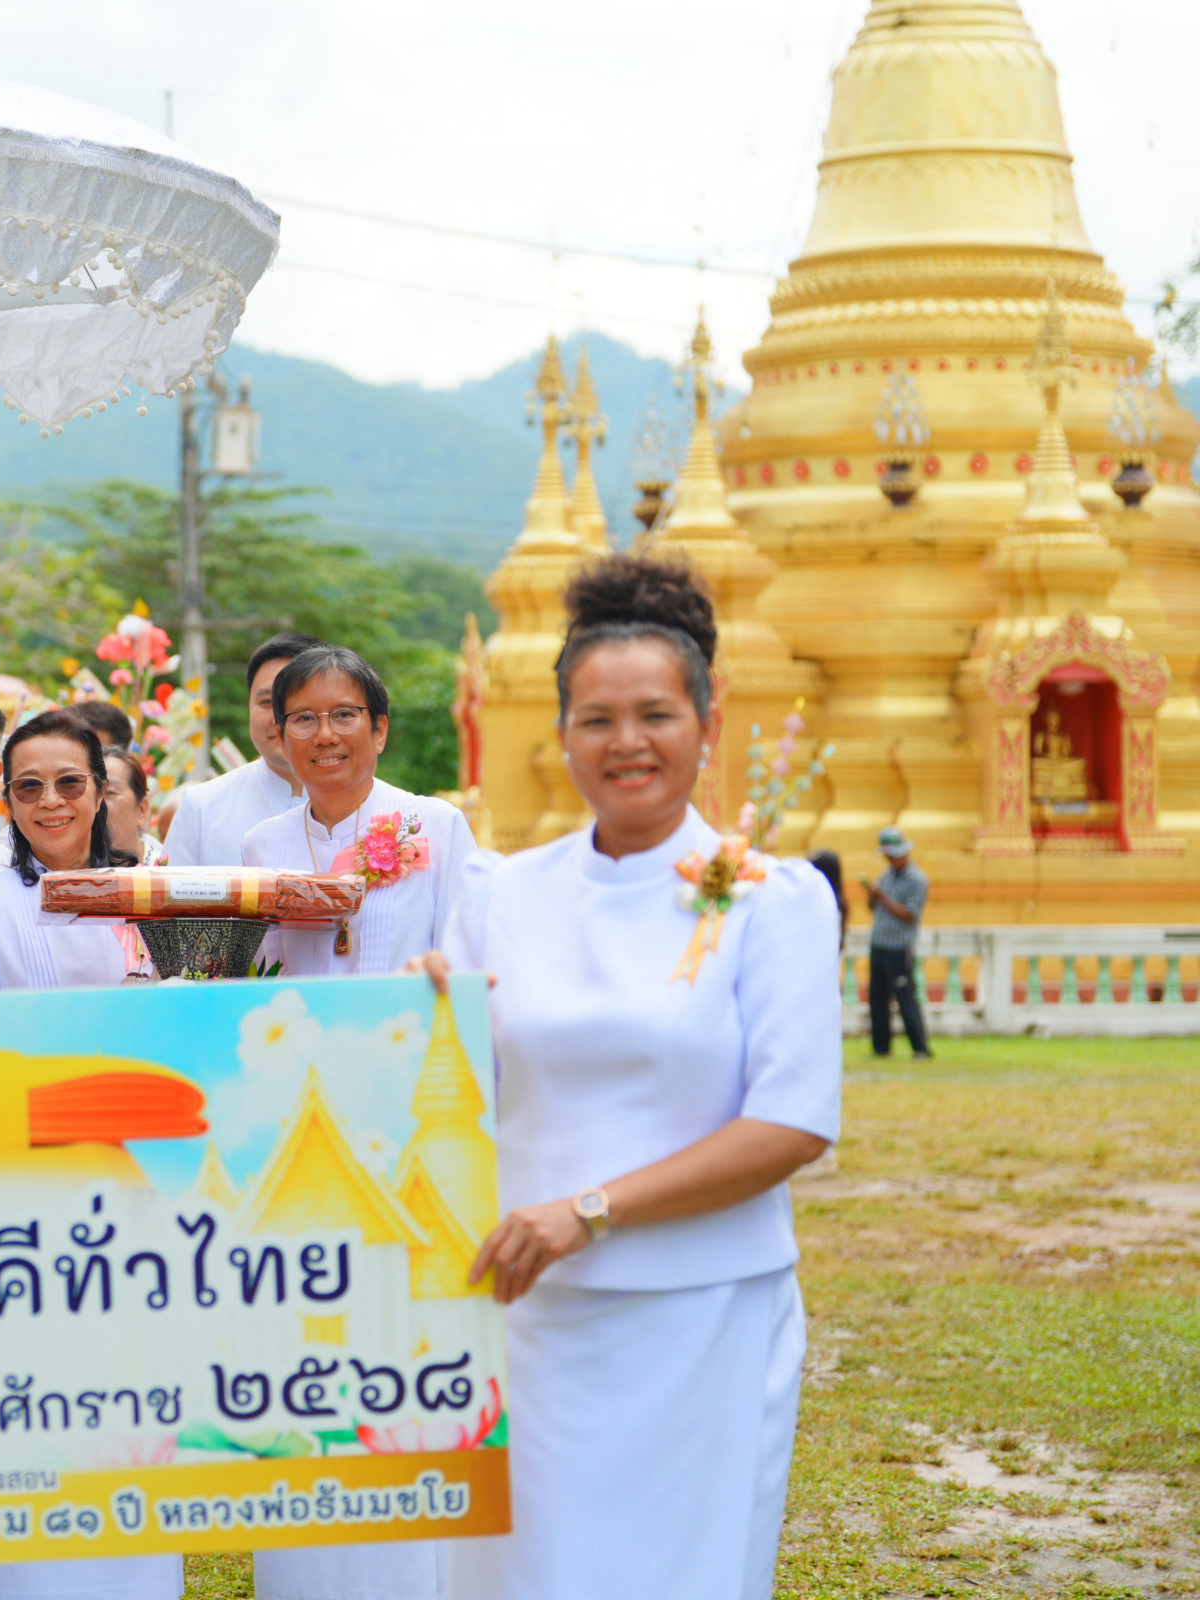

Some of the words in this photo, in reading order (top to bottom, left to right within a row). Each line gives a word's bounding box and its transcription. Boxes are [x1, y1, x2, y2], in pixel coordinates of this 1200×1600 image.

[211, 1351, 475, 1420] ๒๕๖๘
[46, 1508, 99, 1533] ๘๑
[117, 1492, 141, 1530] ปี
[160, 1477, 464, 1527] หลวงพ่อธัมมชโย
